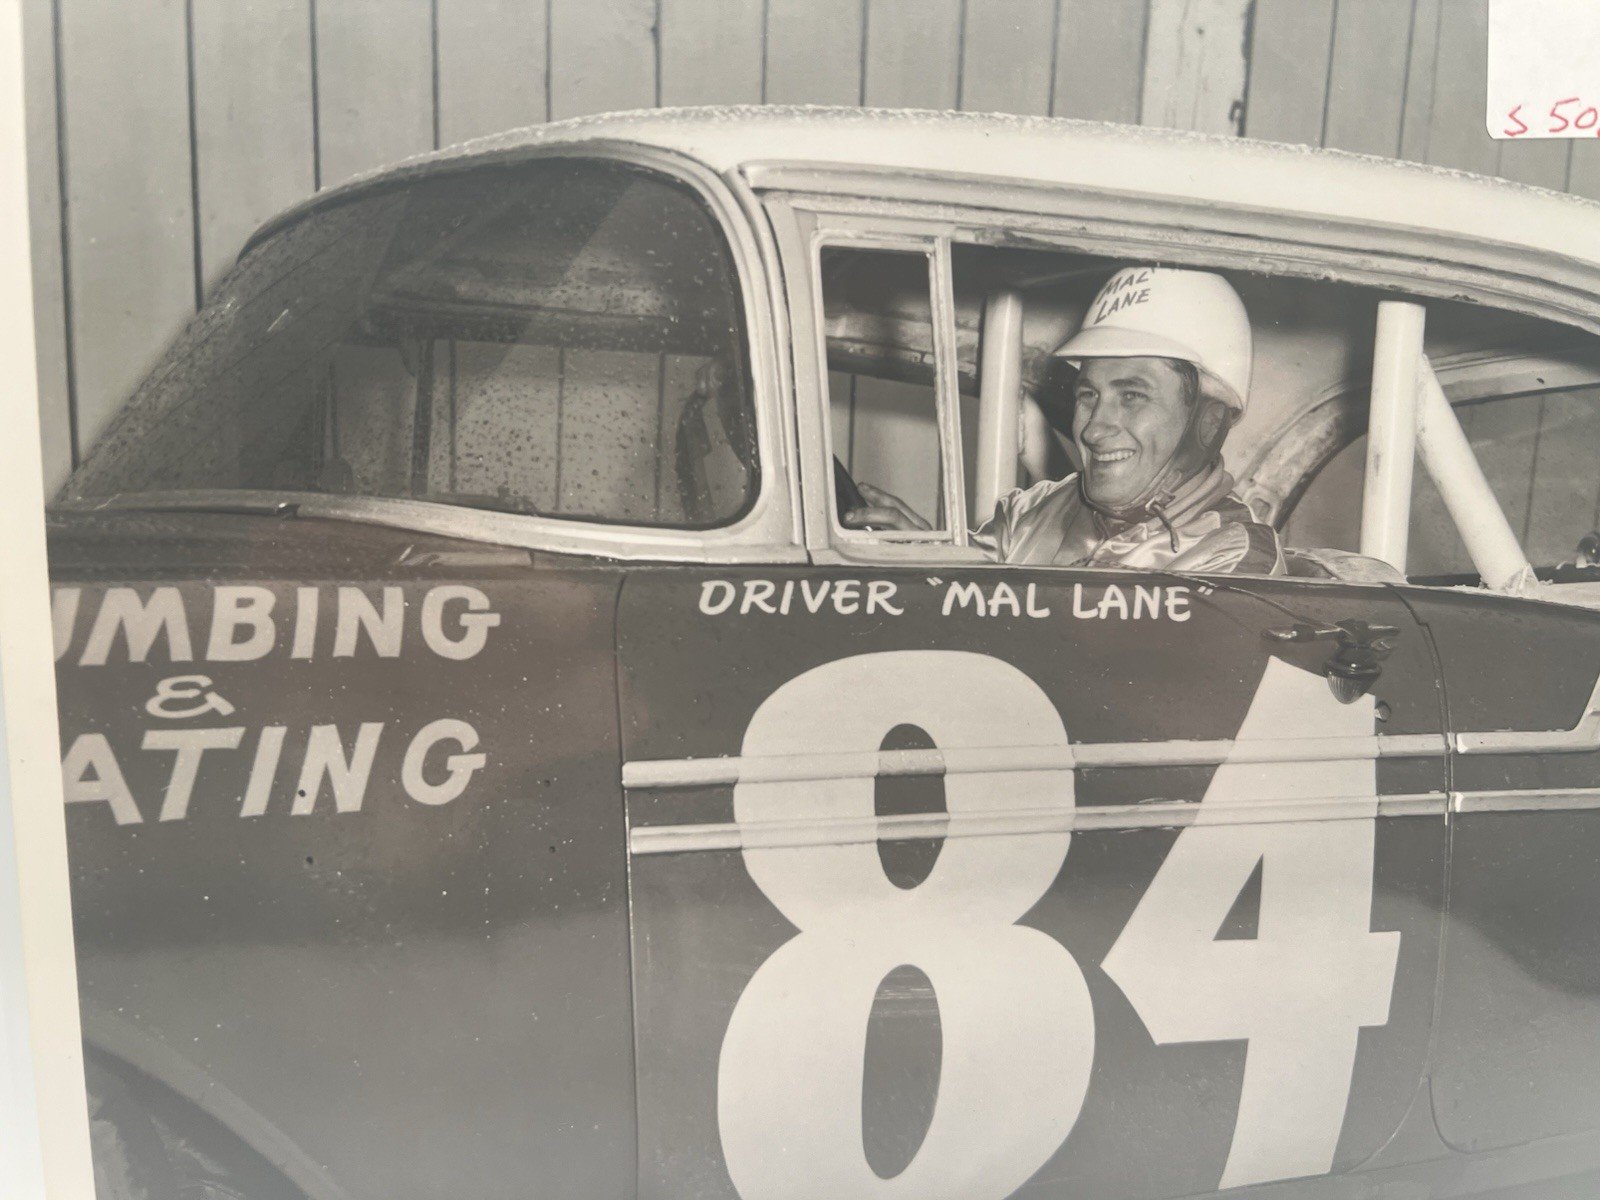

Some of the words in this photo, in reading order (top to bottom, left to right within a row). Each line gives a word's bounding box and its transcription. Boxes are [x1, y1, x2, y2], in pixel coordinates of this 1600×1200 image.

[1092, 287, 1151, 326] LANE
[1095, 269, 1150, 306] MAL
[698, 578, 905, 616] DRIVER
[926, 576, 1051, 618] "MAL
[1072, 583, 1214, 623] LANE"
[144, 674, 236, 719] &
[61, 718, 487, 826] ATING
[717, 649, 1402, 1200] 84
